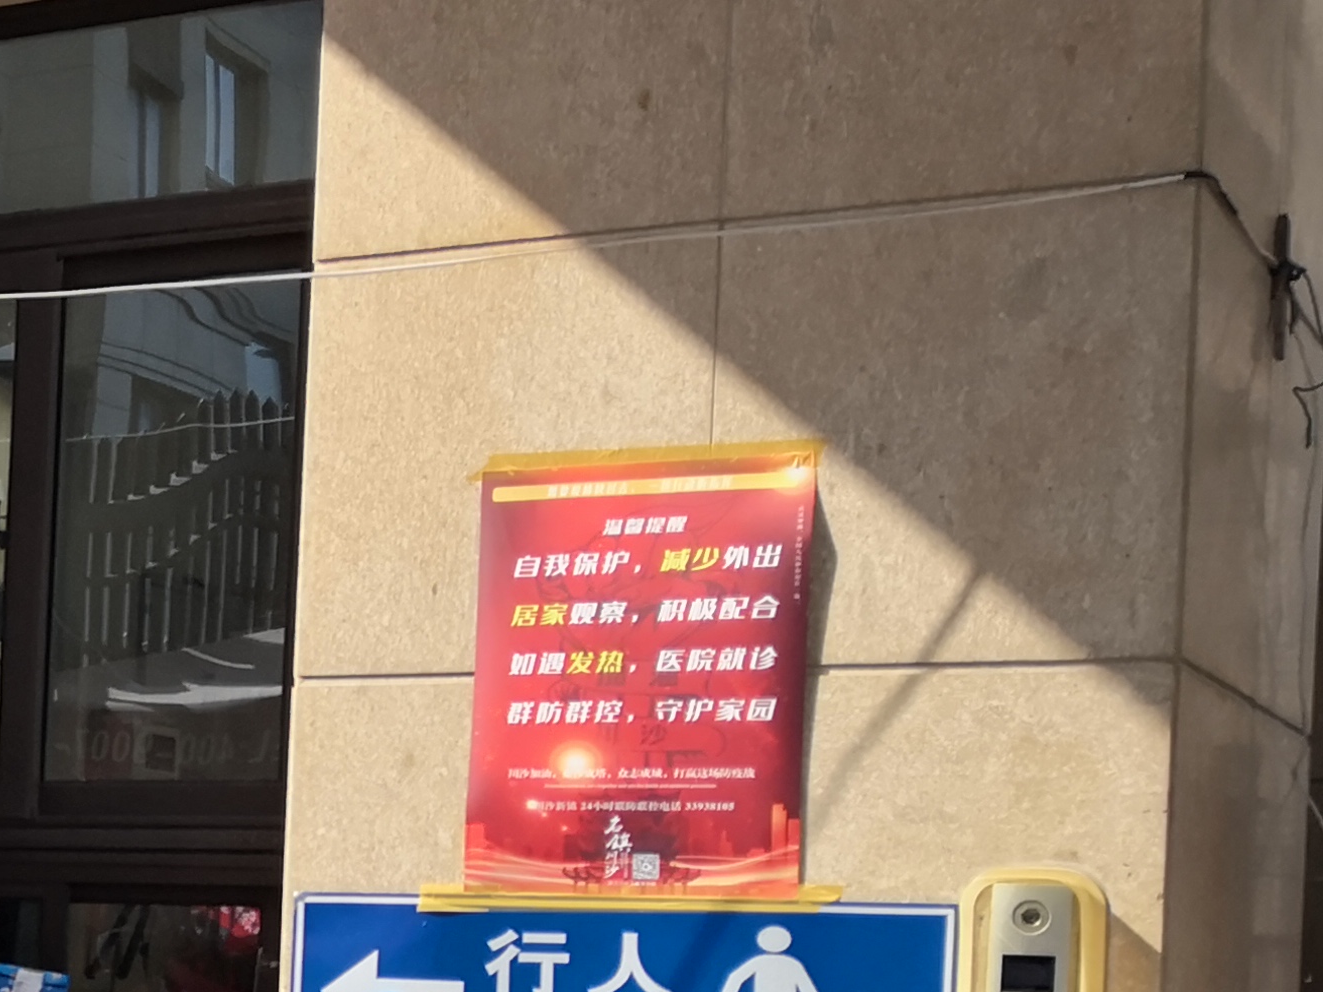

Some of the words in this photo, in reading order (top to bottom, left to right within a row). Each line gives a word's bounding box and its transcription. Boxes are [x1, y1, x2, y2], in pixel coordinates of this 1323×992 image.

[603, 515, 687, 536] 温馨提醒
[513, 543, 782, 578] 自我保护，减少外出
[510, 595, 780, 628] 居家观察，积极配合
[509, 646, 778, 676] 如遇发热，医院就诊
[506, 696, 777, 726] 群防群控，守护家园
